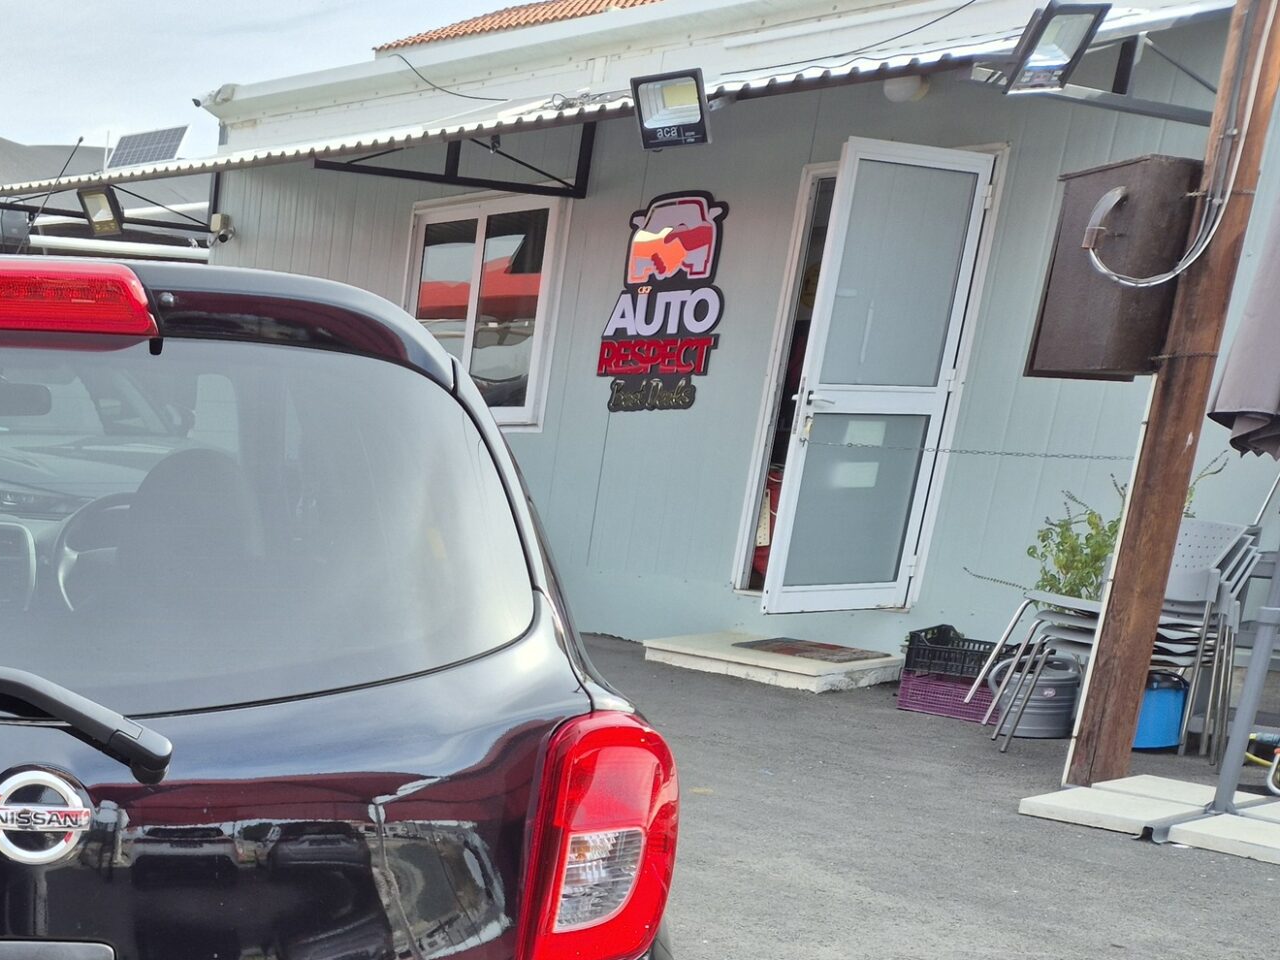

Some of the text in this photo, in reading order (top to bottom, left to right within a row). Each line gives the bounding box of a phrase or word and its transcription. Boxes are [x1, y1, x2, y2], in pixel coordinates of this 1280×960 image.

[656, 126, 678, 138] aca
[603, 287, 721, 336] AUTO
[597, 336, 714, 376] RESPECT
